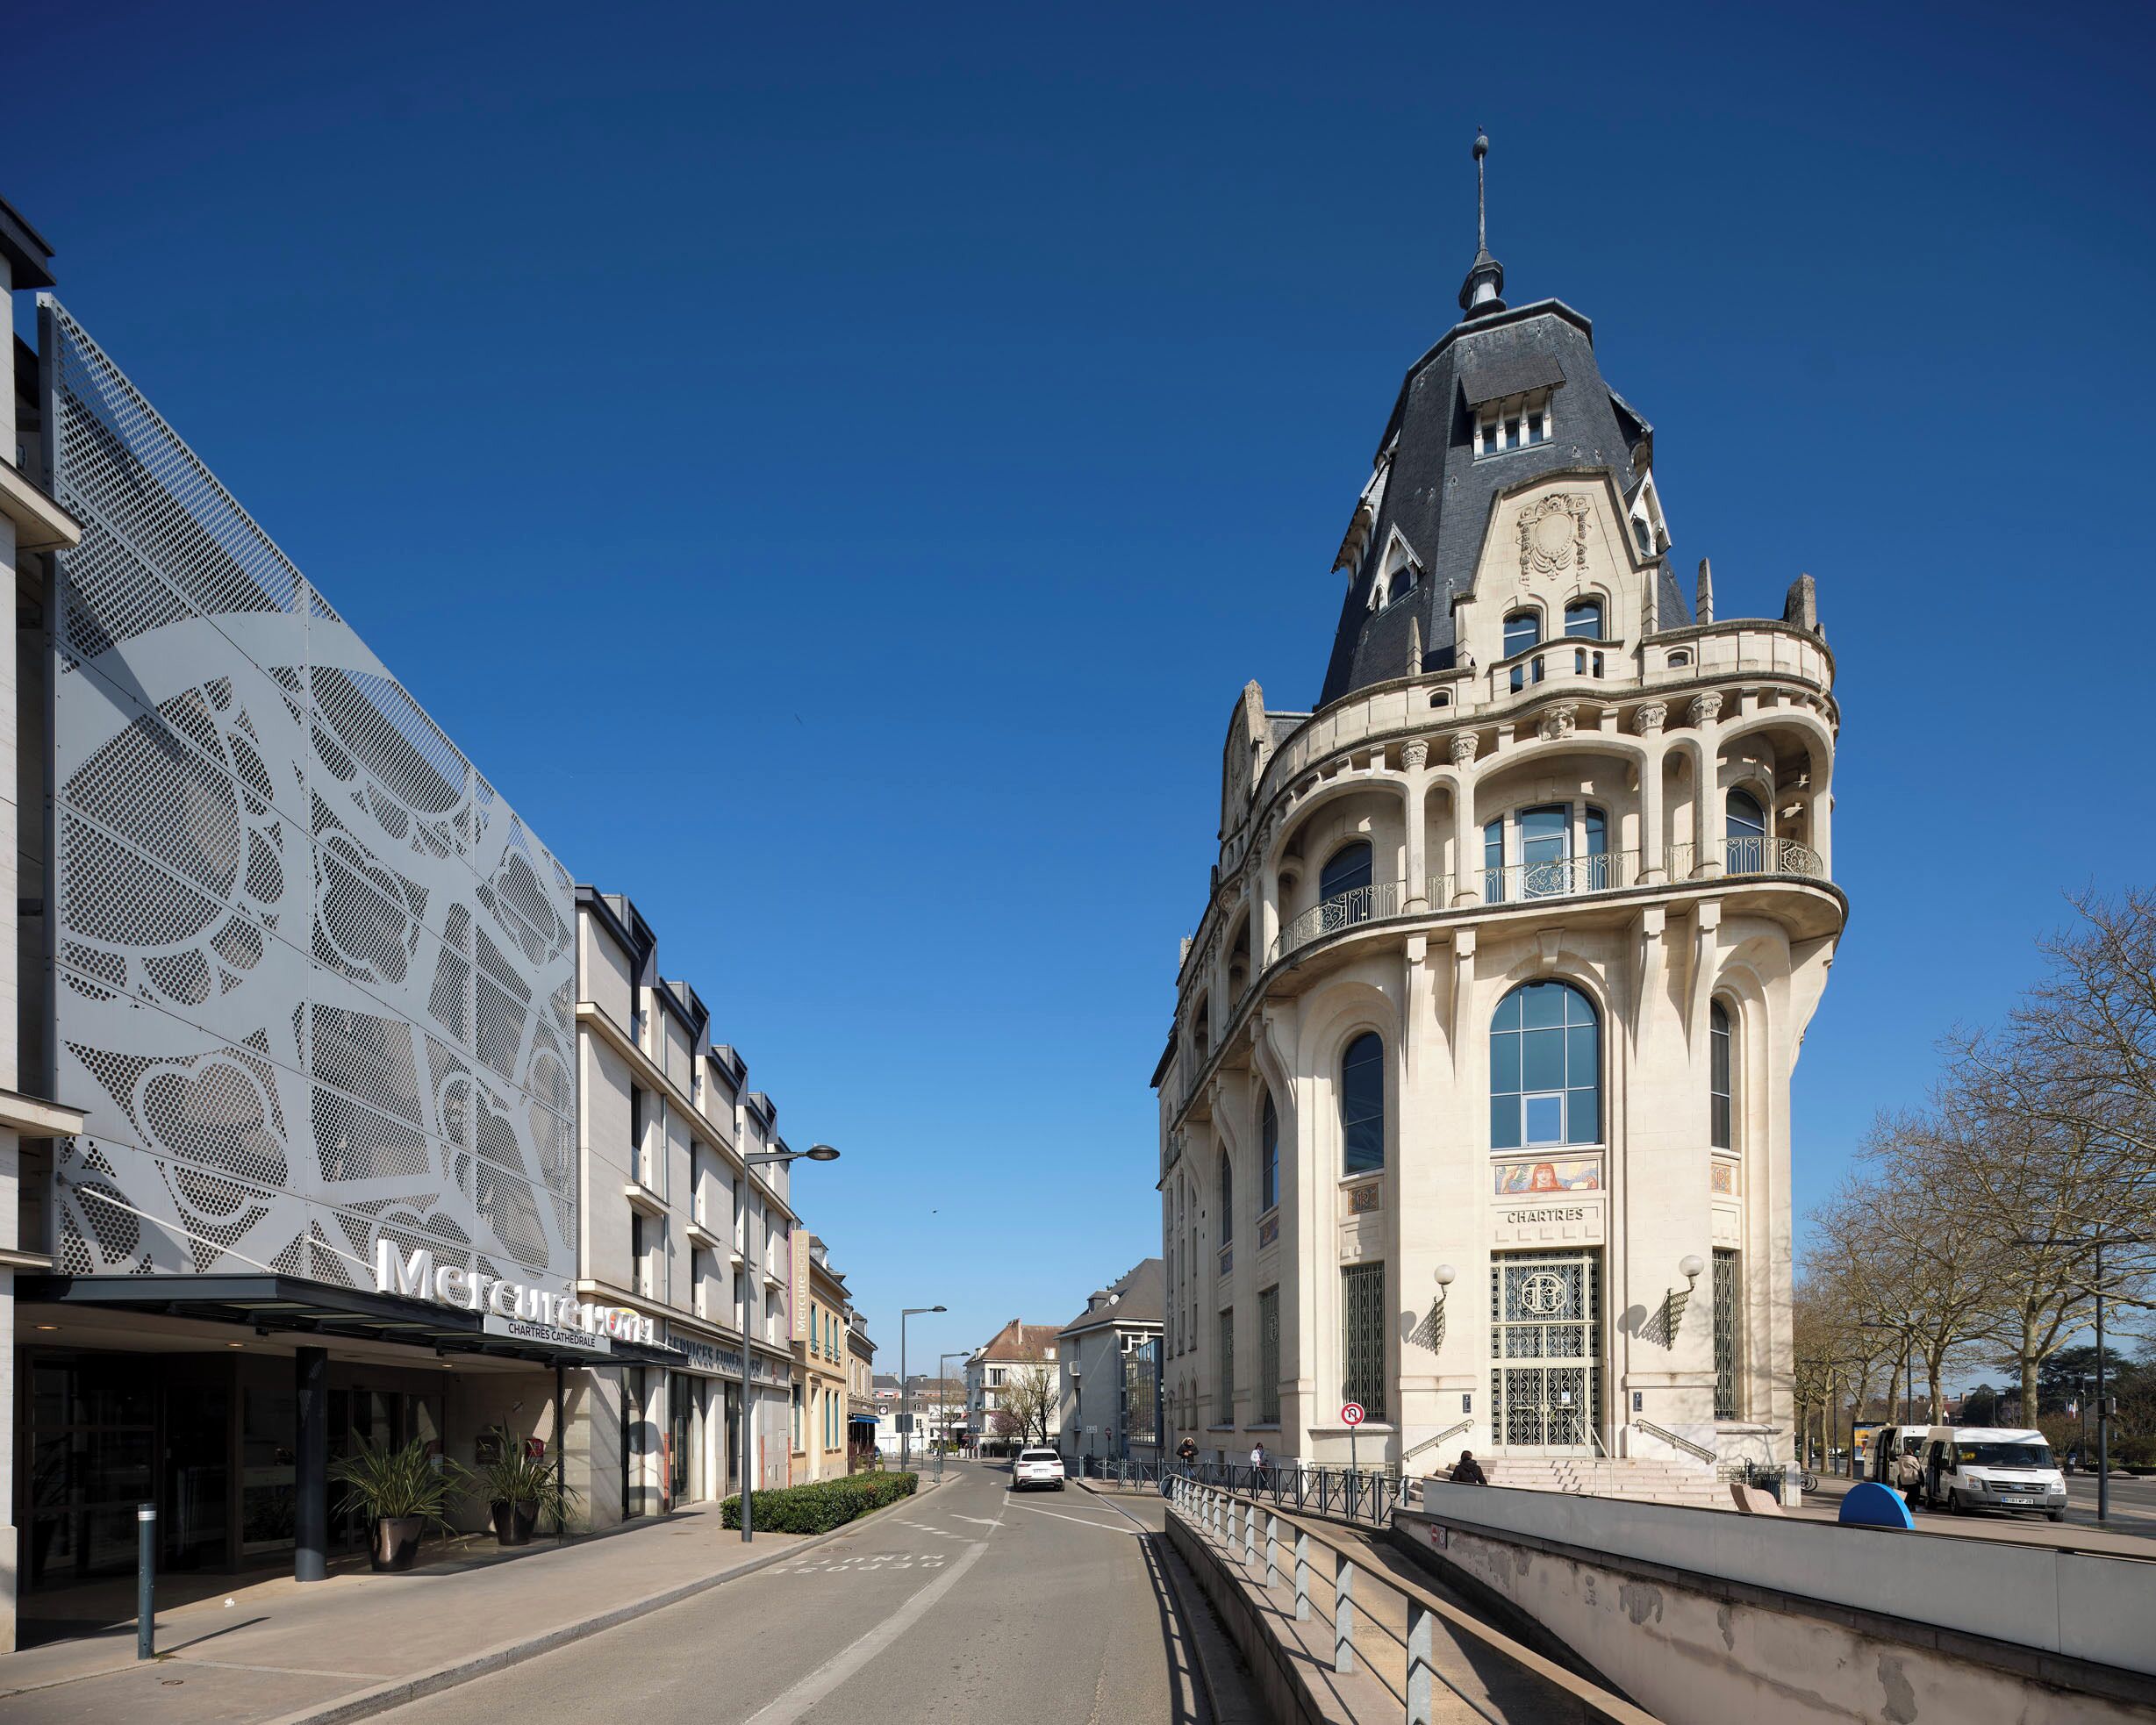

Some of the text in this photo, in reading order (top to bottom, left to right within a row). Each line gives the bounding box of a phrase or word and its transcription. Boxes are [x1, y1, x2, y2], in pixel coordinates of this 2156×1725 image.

[1507, 1208, 1584, 1224] CHARTRES
[377, 1239, 584, 1333] Mercure
[796, 1239, 806, 1333] Mercure HOTEL
[508, 1323, 596, 1347] CHARTRES CATHEDRALE
[667, 1334, 713, 1361] SERVICES
[758, 1561, 945, 1575] DEPOSE
[787, 1554, 945, 1566] MINUTE
